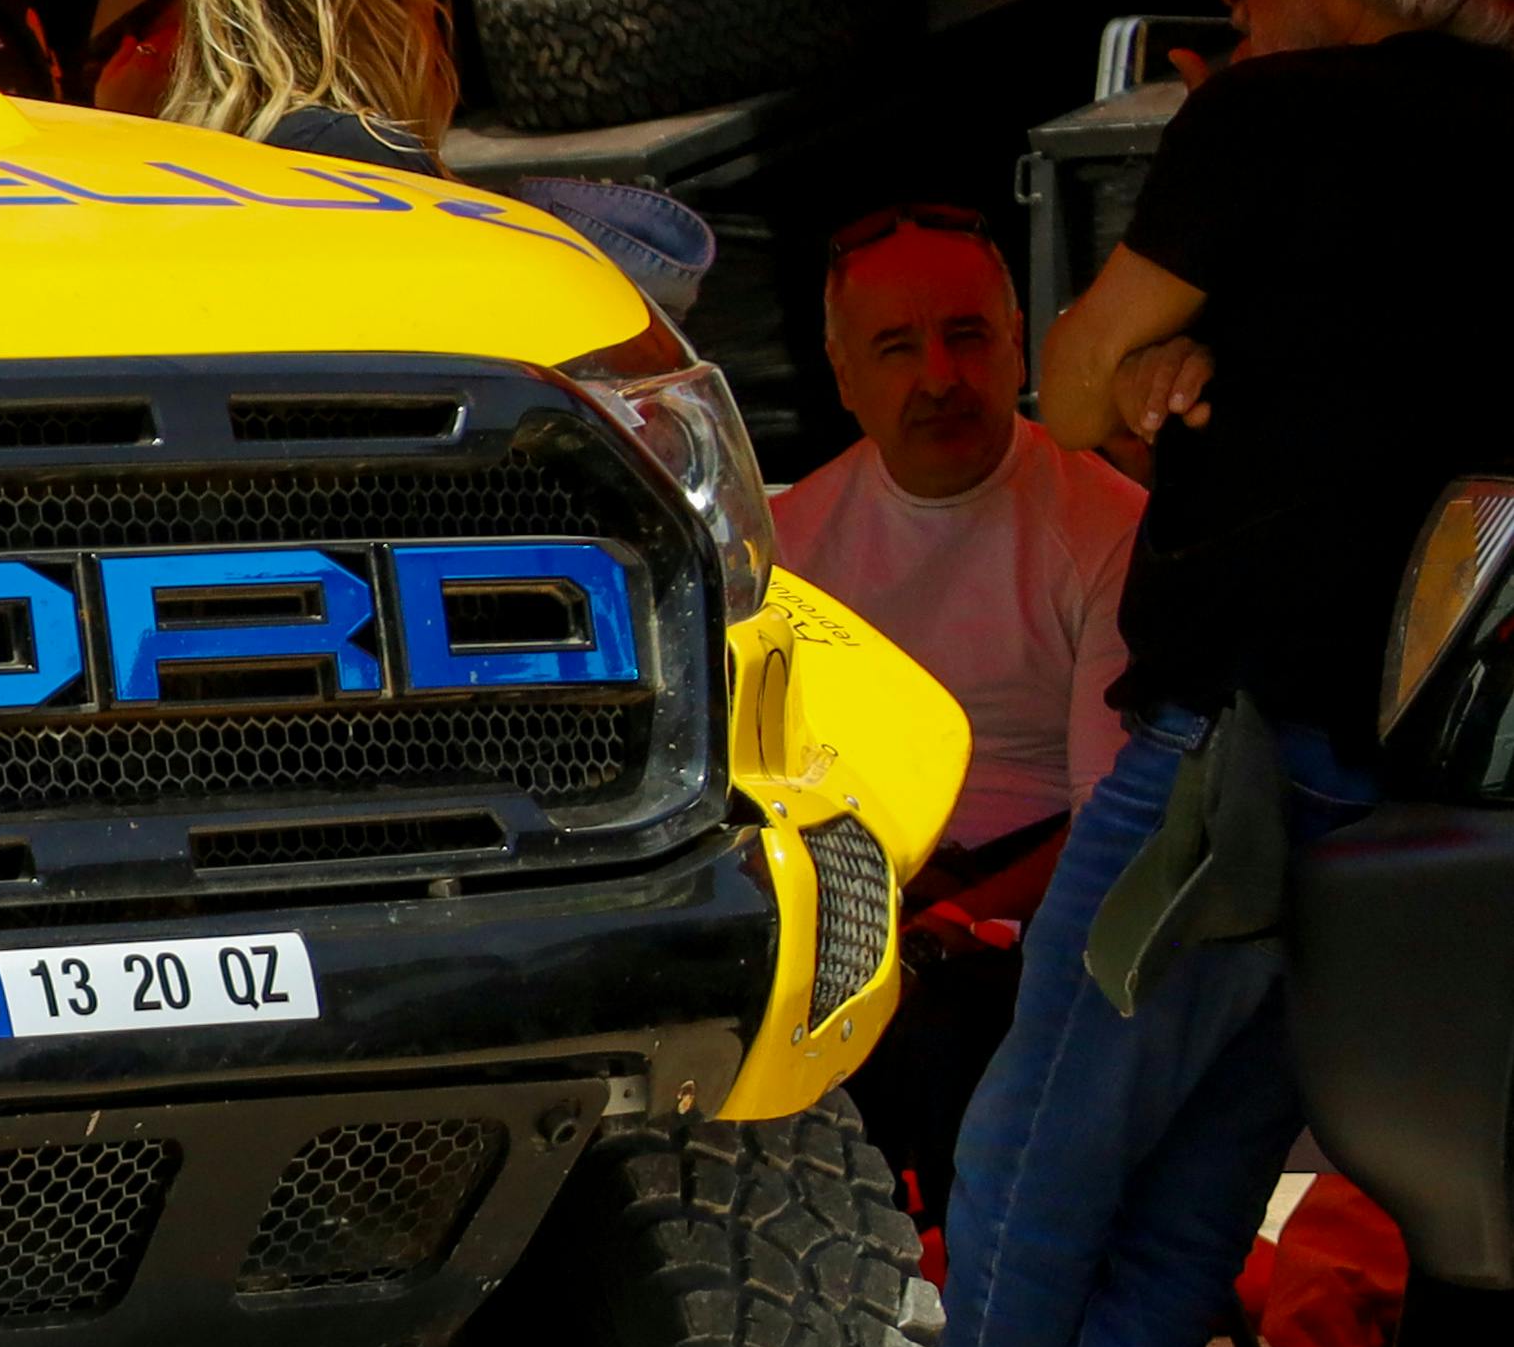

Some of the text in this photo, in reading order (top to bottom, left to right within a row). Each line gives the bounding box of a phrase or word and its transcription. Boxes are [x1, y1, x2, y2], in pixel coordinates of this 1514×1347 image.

[30, 957, 99, 1018] 13
[123, 951, 192, 1012] 20
[218, 945, 290, 1011] QZ
